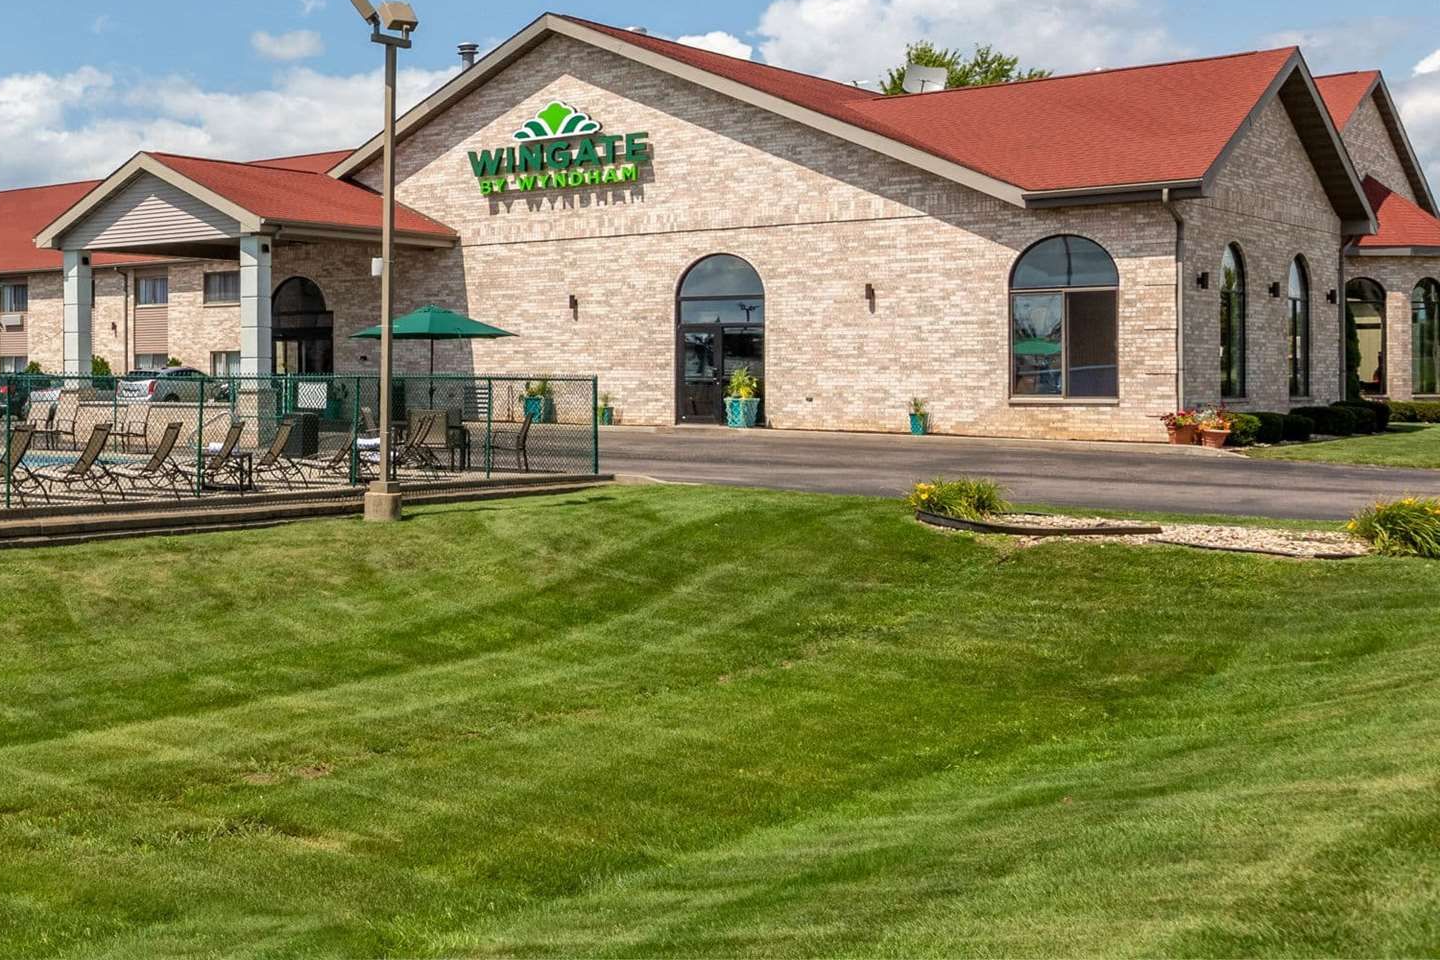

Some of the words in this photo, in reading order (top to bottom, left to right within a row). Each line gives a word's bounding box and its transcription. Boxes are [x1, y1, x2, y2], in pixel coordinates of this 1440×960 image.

[467, 132, 650, 177] WINGATE
[480, 178, 507, 195] BY
[517, 166, 639, 192] WYNDHAM
